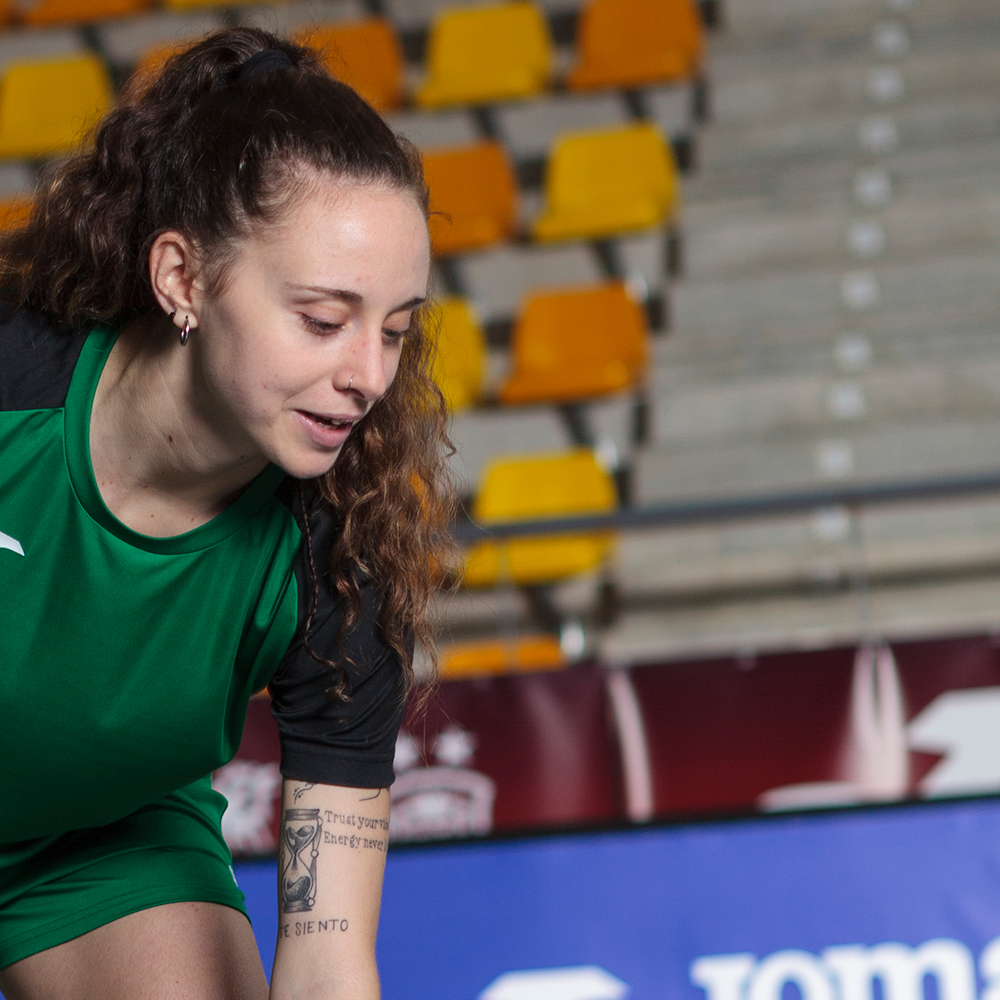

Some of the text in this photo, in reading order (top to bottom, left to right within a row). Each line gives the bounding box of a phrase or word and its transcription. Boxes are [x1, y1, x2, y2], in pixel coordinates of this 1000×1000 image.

[324, 810, 356, 826] Trust
[357, 816, 379, 830] your
[323, 831, 362, 849] Energy
[363, 838, 384, 852] never
[295, 919, 349, 937] SIENTO
